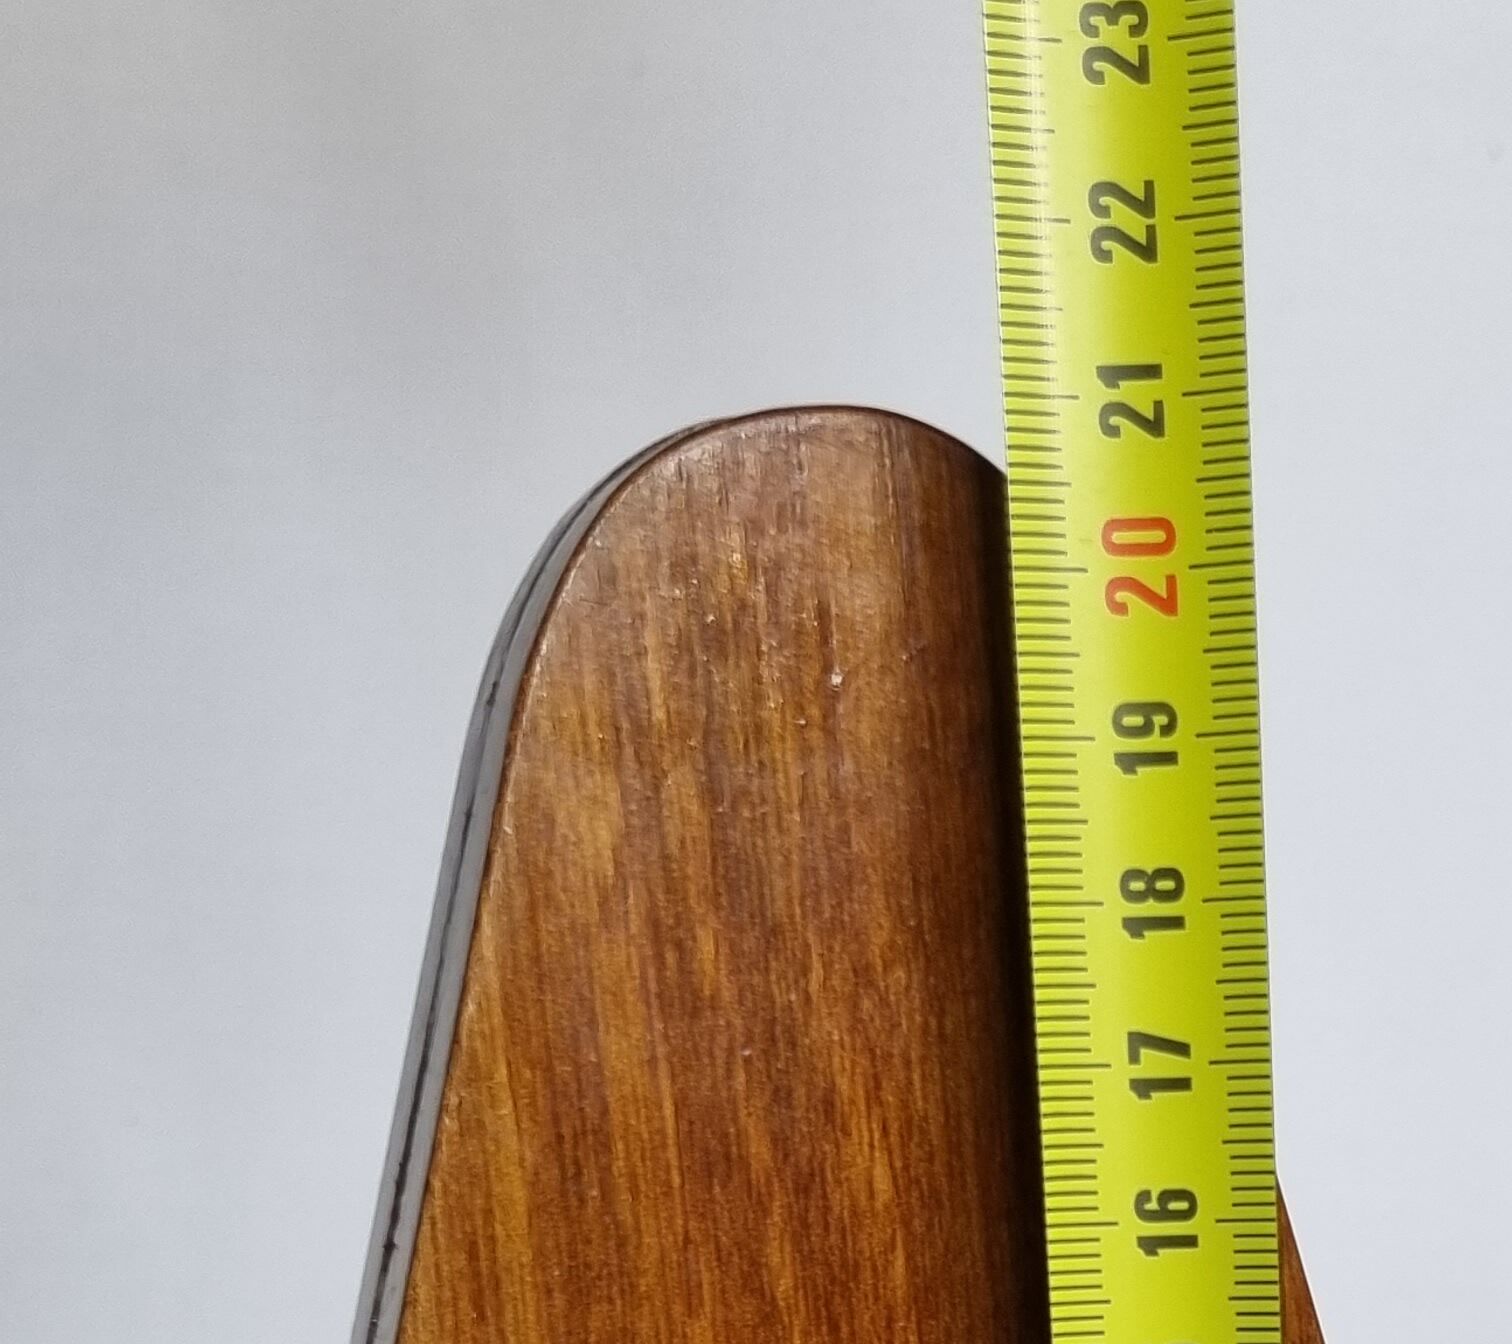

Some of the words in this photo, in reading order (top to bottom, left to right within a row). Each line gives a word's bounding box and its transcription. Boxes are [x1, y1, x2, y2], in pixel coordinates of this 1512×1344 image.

[1080, 0, 1150, 85] 23
[1087, 179, 1158, 263] 22
[1095, 363, 1164, 438] 21
[1102, 516, 1180, 617] 20
[1113, 701, 1179, 774] 19
[1120, 867, 1186, 938] 18
[1127, 1031, 1192, 1100] 17
[1134, 1188, 1199, 1256] 16
